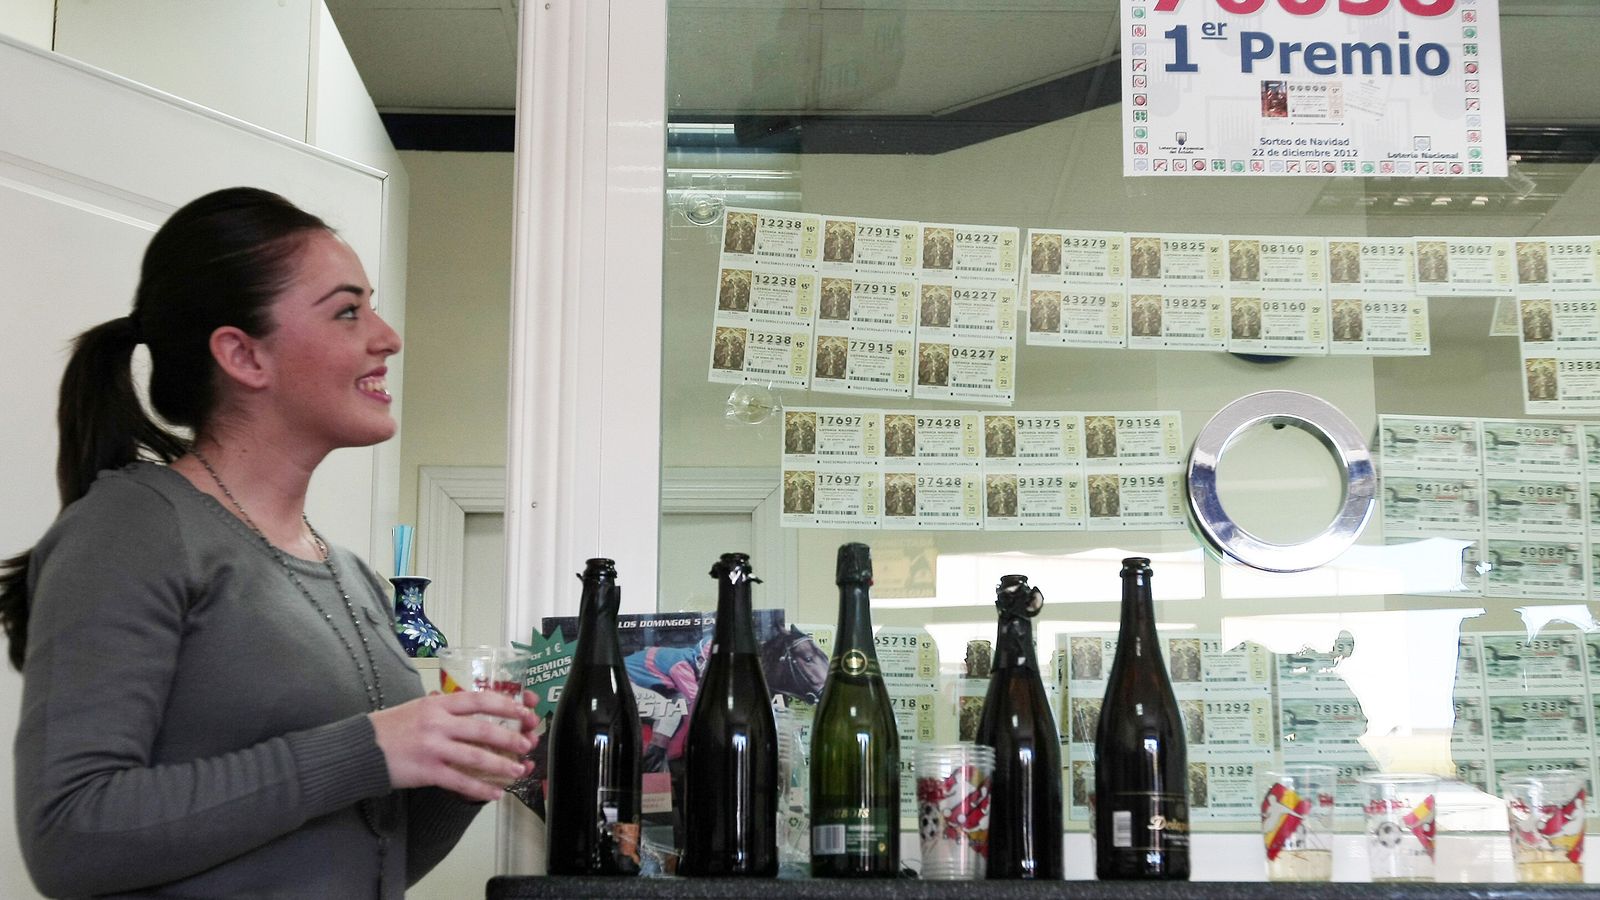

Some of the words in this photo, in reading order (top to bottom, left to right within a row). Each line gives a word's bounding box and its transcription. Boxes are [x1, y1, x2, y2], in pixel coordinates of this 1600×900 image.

[1240, 31, 1450, 76] Premio
[1260, 137, 1292, 146] Sorteo
[1295, 137, 1307, 146] de
[1310, 137, 1350, 146] Navidad
[1252, 149, 1265, 157] 22
[1267, 149, 1280, 157] de
[1282, 149, 1331, 157] diciembre
[1333, 149, 1358, 158] 2012
[760, 218, 802, 229] 12238
[858, 226, 900, 237] 77915
[956, 232, 999, 243] 04227
[1063, 238, 1107, 248] 43279
[1163, 241, 1206, 251] 19825
[1261, 243, 1304, 254] 08160
[1361, 245, 1405, 256] 68132
[1449, 245, 1492, 255] 38067
[1549, 244, 1592, 255] 13582
[754, 274, 797, 286] 12238
[853, 283, 897, 294] 77915
[953, 289, 997, 300] 04227
[1062, 295, 1106, 305] 43279
[1164, 298, 1207, 308] 19825
[1262, 301, 1306, 312] 08160
[1364, 302, 1408, 313] 68132
[1554, 302, 1598, 313] 13582
[749, 333, 792, 345] 12238
[850, 341, 893, 353] 77915
[951, 348, 995, 359] 04227
[819, 415, 862, 426] 17697
[917, 417, 961, 428] 97428
[1017, 417, 1060, 428] 91375
[1117, 417, 1161, 428] 79154
[1414, 425, 1458, 435] 94146
[1515, 428, 1561, 437] 40084
[818, 474, 861, 485] 17697
[918, 476, 962, 487] 97428
[1019, 476, 1063, 487] 91375
[1120, 475, 1165, 486] 79154
[1416, 483, 1460, 493] 94146
[1518, 486, 1563, 496] 40084
[1520, 547, 1565, 556] 40084
[617, 620, 637, 629] LOS
[639, 618, 691, 628] DOMINGOS
[693, 618, 701, 626] 5
[527, 652, 543, 661] or
[554, 642, 562, 653] €
[526, 655, 572, 676] REMIOS
[891, 698, 916, 709] 718
[1207, 703, 1251, 713] 11292
[1315, 704, 1359, 714] 78591
[1211, 765, 1254, 776] 11292
